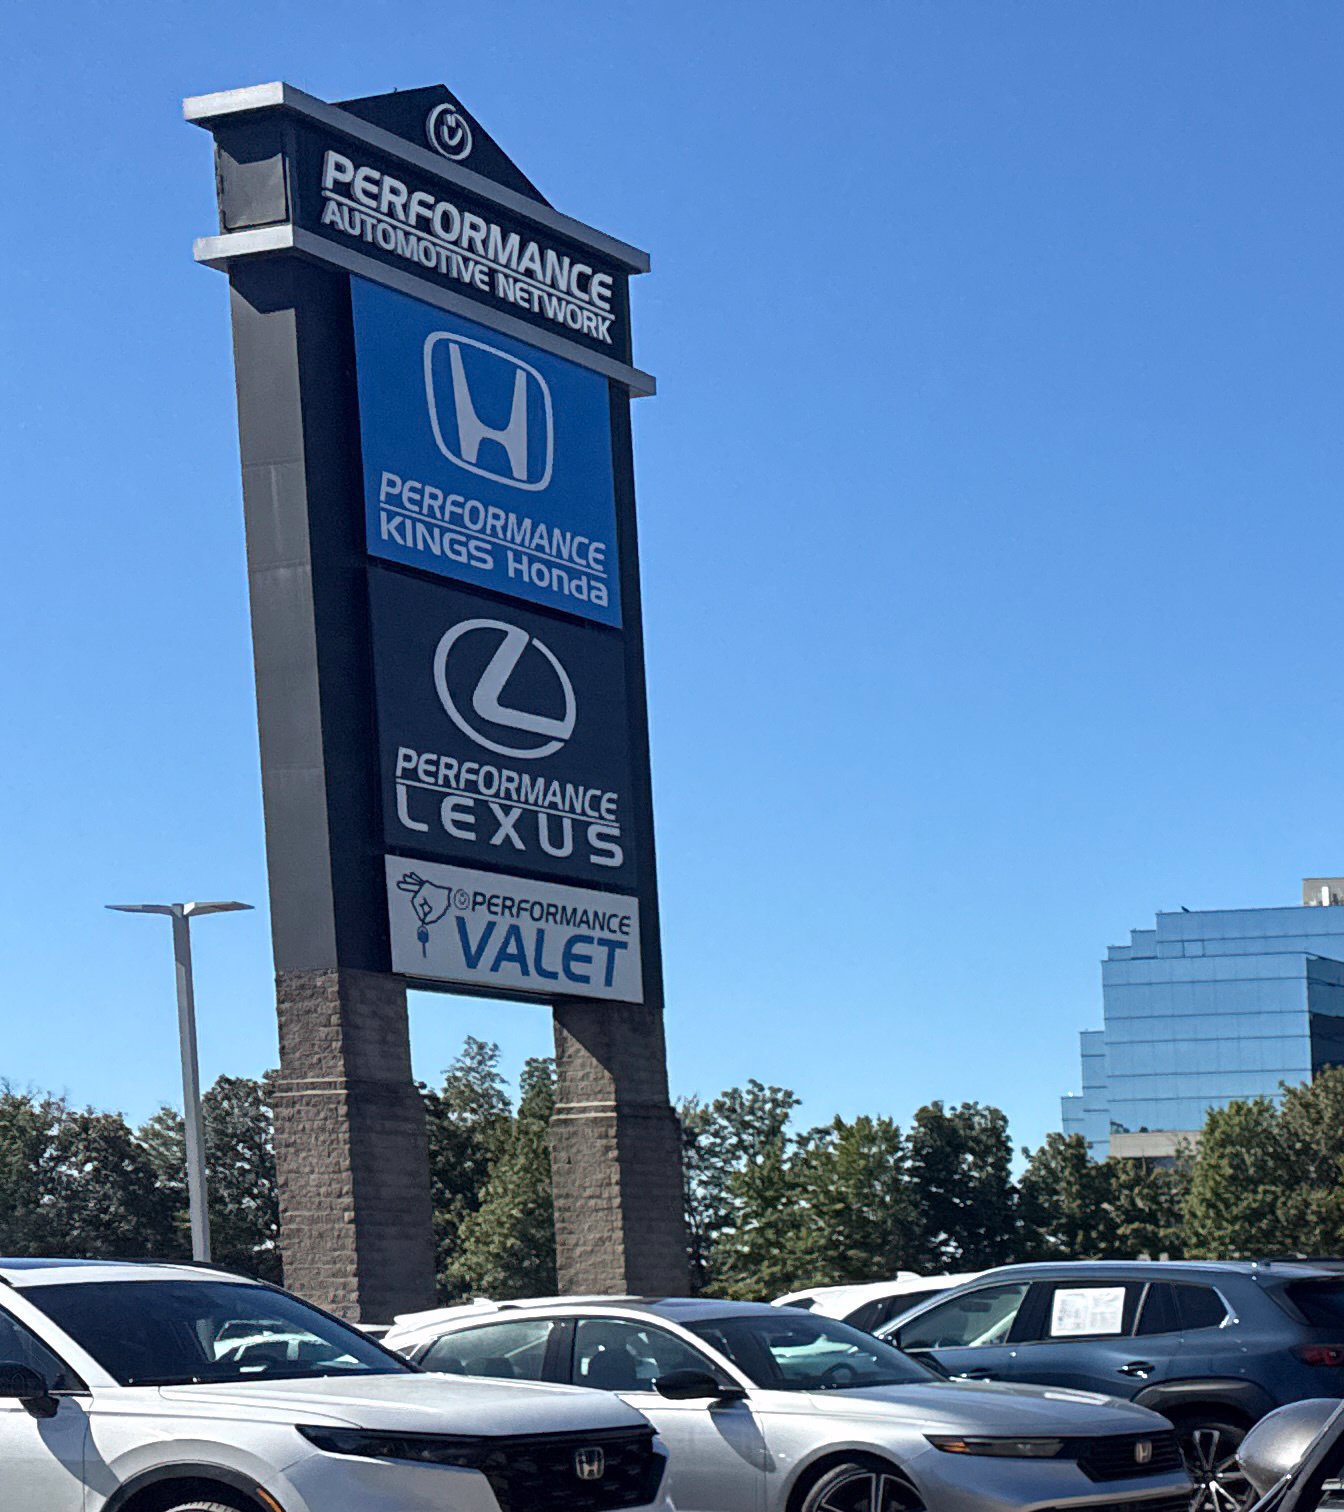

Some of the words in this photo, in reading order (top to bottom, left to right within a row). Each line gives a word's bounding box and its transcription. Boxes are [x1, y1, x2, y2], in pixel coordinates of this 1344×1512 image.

[321, 150, 614, 311] PERFORMANCE
[321, 200, 490, 292] AUTOMOTIVE
[495, 272, 615, 345] NETWORK
[379, 471, 606, 572] PERFORMANCE
[379, 510, 494, 570] KINGS
[506, 550, 609, 607] Honda
[395, 746, 618, 821] PERFORMANCE
[396, 783, 624, 867] LEXUS
[455, 916, 629, 988] VALET
[472, 891, 632, 936] PERFORMANCE
